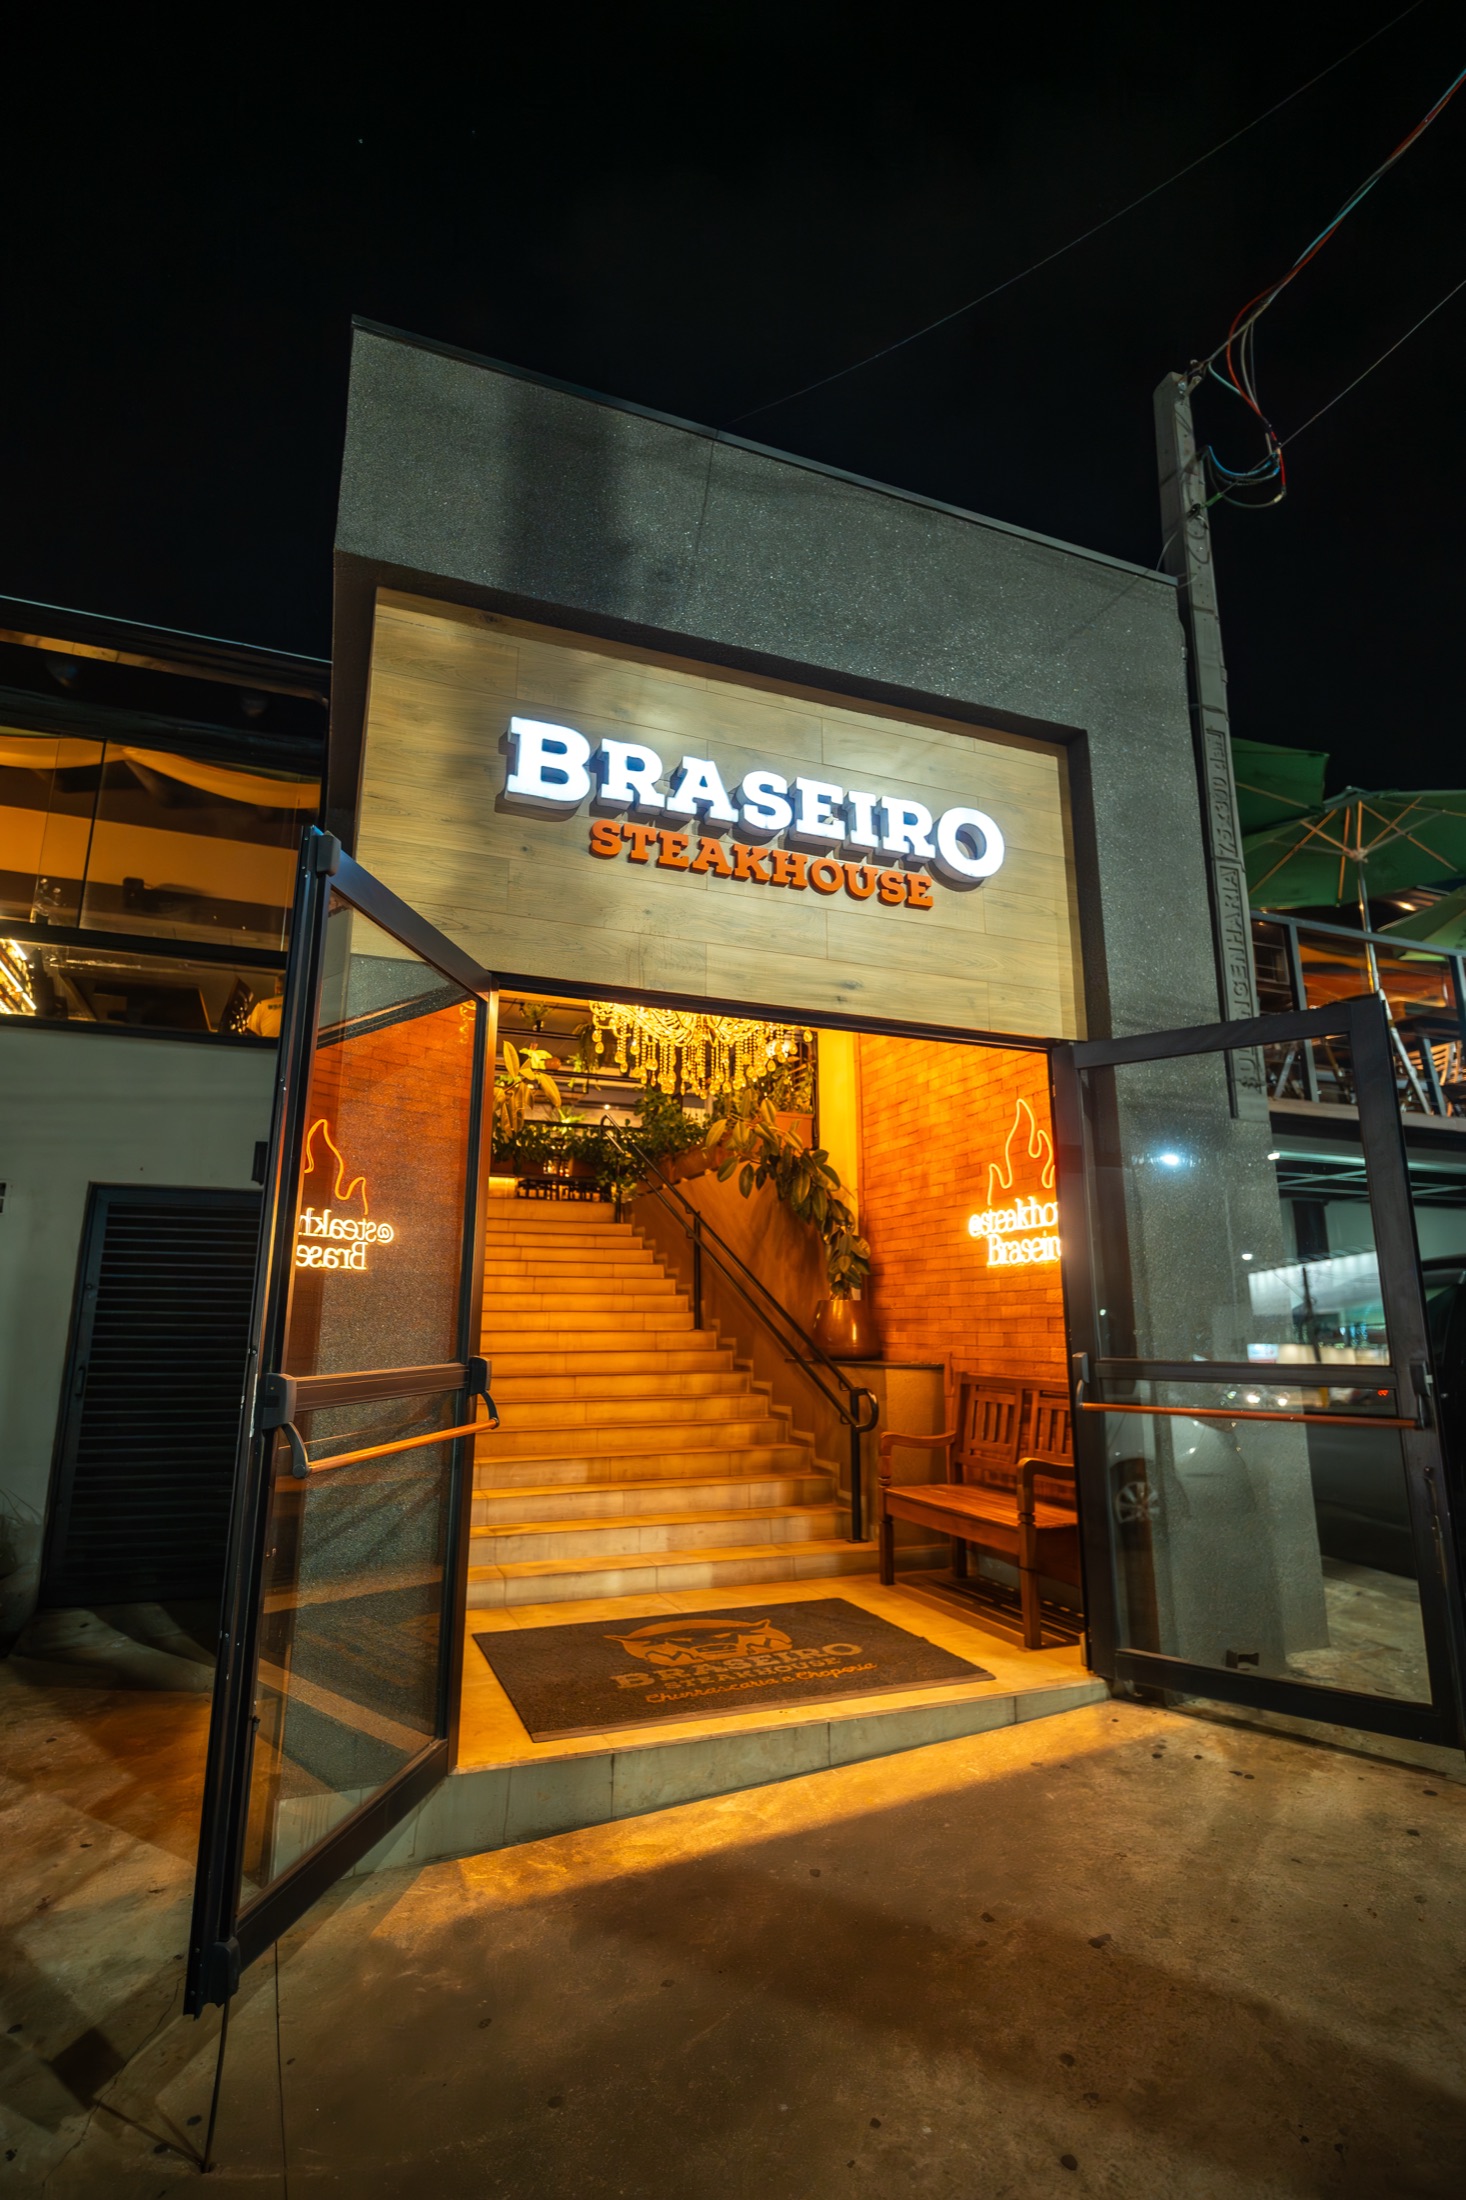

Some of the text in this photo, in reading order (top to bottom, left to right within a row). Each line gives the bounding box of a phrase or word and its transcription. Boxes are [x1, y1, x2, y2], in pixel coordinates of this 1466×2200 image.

[506, 716, 1005, 881] BRASEIRO
[589, 819, 934, 909] STEAKHOUSE
[1219, 867, 1250, 1020] NGENHARIA
[609, 1642, 863, 1690] BRASEIRO
[663, 1656, 841, 1690] STEAKHOUSE
